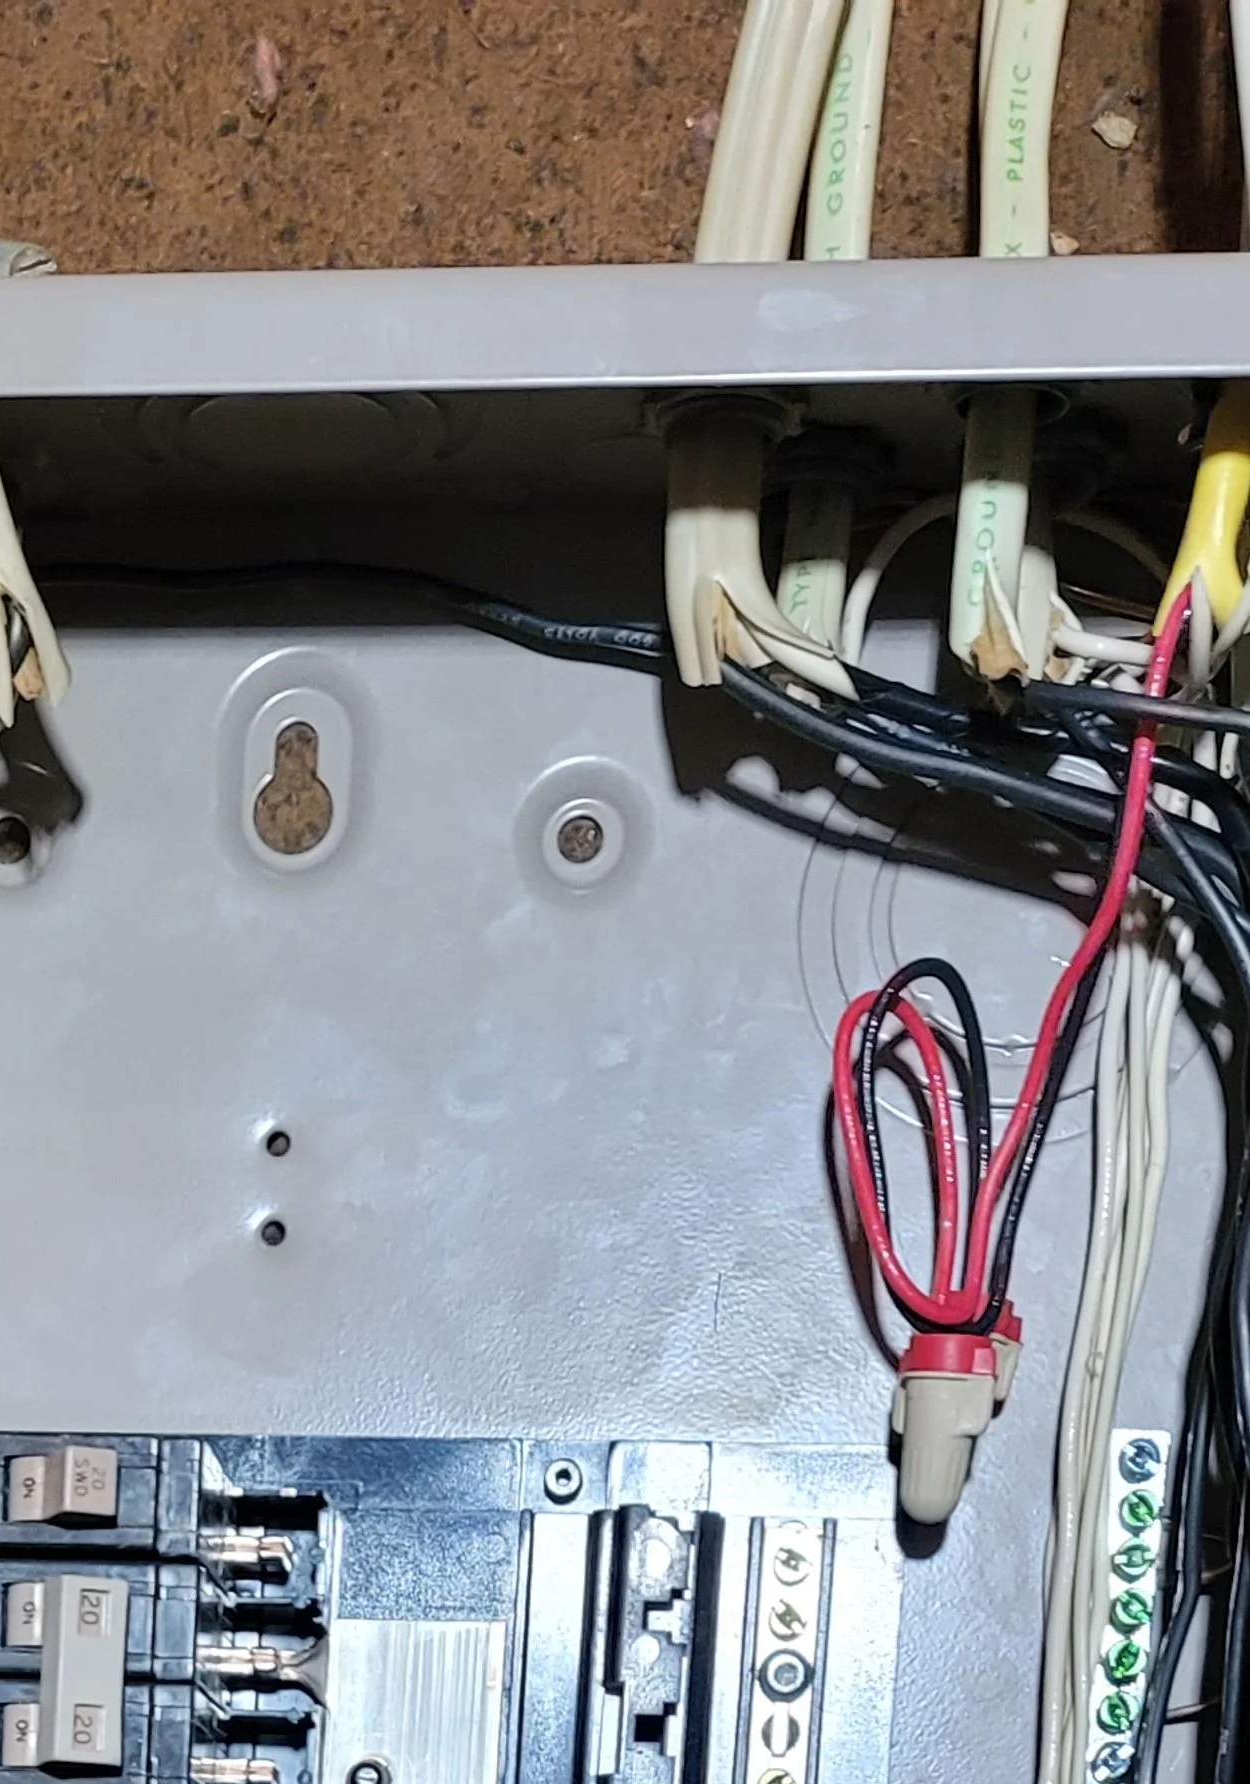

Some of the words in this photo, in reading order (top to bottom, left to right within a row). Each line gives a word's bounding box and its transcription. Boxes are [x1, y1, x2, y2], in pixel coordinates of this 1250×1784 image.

[1006, 63, 1033, 183] PLASTIC
[74, 1458, 88, 1496] SWD
[80, 1595, 99, 1626] 20
[15, 1720, 29, 1742] ON
[74, 1715, 93, 1744] 20
